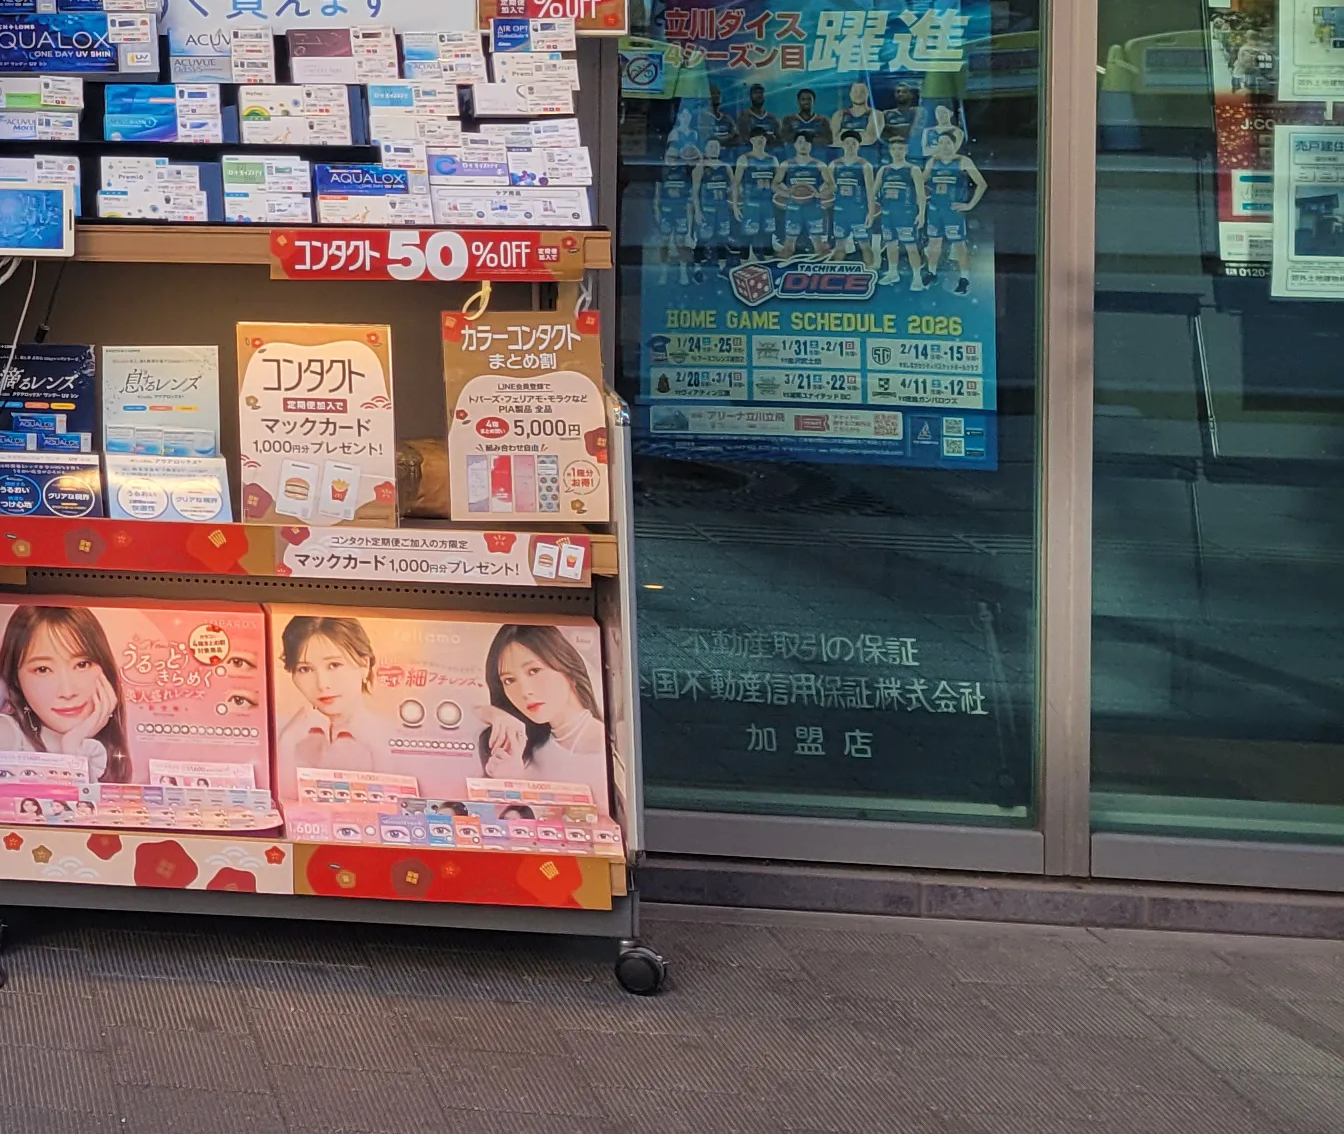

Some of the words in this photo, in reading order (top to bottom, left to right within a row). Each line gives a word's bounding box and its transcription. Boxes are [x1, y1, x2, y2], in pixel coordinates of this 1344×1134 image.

[664, 8, 807, 42] 立川ダイス
[808, 8, 971, 73] 躍進
[55, 51, 75, 59] DAY
[75, 50, 90, 59] UV
[330, 173, 406, 185] AQUALOX
[294, 239, 380, 272] コンタクト
[386, 229, 469, 282] 50
[471, 240, 532, 269] %OFF
[798, 264, 863, 273] TACHIKAWA
[781, 273, 874, 291] DICE
[666, 310, 718, 329] HOME
[726, 311, 781, 331] GAME
[790, 312, 897, 334] SCHEDULE
[906, 315, 963, 336] 2026
[460, 324, 582, 352] カラーコンタクト
[488, 352, 558, 370] まとめ割
[119, 368, 205, 394] 息するレンズ
[261, 357, 366, 394] コンタクト
[286, 399, 345, 412] 定期便加入で
[535, 404, 553, 414] 全品
[260, 417, 372, 438] マックカード
[513, 418, 582, 437] 5,000円
[253, 437, 384, 456] 1,000円分プレゼント!
[485, 443, 540, 453] 組み合わせ自由
[330, 535, 469, 551] コンタクト定期便ご加入の方限定
[294, 551, 520, 578] マックカード1,000円分プレゼント!
[679, 627, 921, 667] 不動産取引の保証
[156, 669, 212, 689] きらめく
[745, 723, 874, 759] 加盟店
